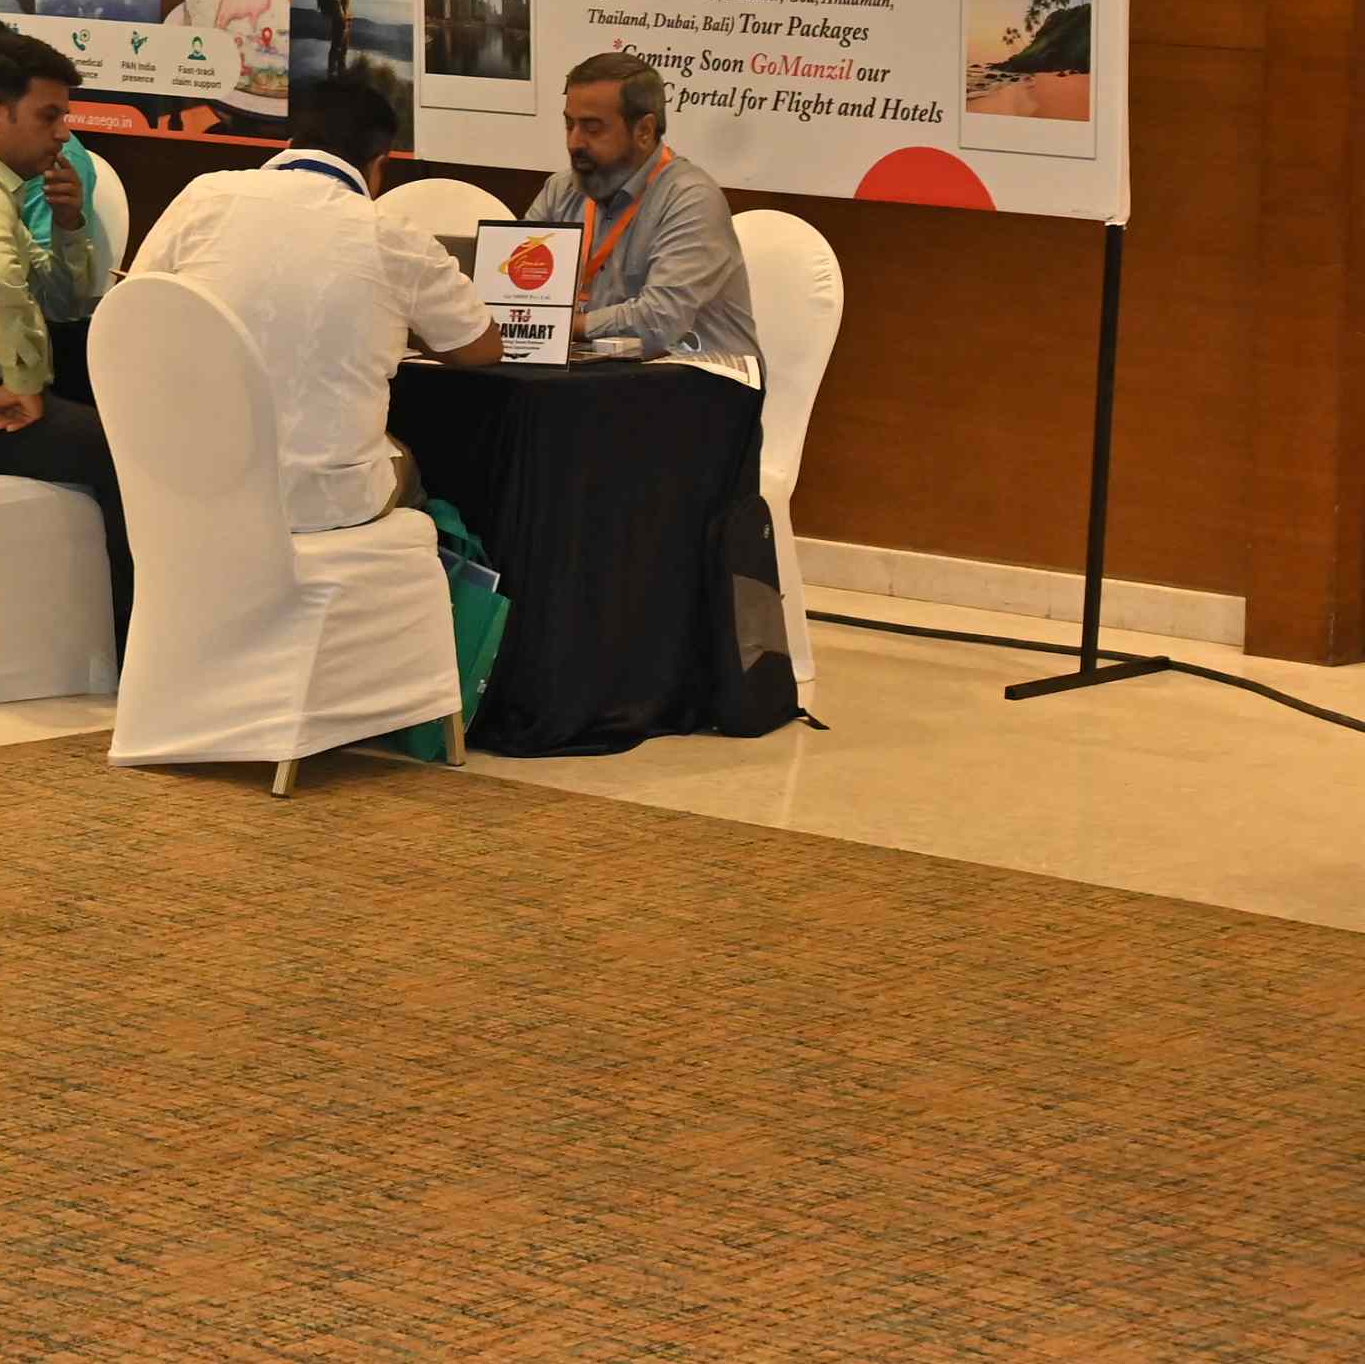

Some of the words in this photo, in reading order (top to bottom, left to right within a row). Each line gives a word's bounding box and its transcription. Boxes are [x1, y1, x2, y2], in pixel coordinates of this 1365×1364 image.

[588, 7, 651, 29] Thailand,
[652, 11, 700, 32] Dubai,
[702, 13, 736, 36] Bali)
[738, 12, 784, 36] Tour
[787, 15, 871, 48] Packages
[75, 57, 103, 68] medical
[138, 61, 157, 72] India
[698, 49, 745, 74] Soon
[749, 52, 854, 82] GoManzil
[856, 64, 891, 84] our
[177, 64, 215, 77] Fast-track
[121, 73, 155, 85] presence
[172, 77, 192, 87] claim
[193, 78, 222, 89] support
[676, 82, 736, 114] portal
[734, 87, 769, 117] for
[771, 88, 835, 123] Flight
[837, 94, 876, 120] and
[878, 96, 944, 125] Hotels
